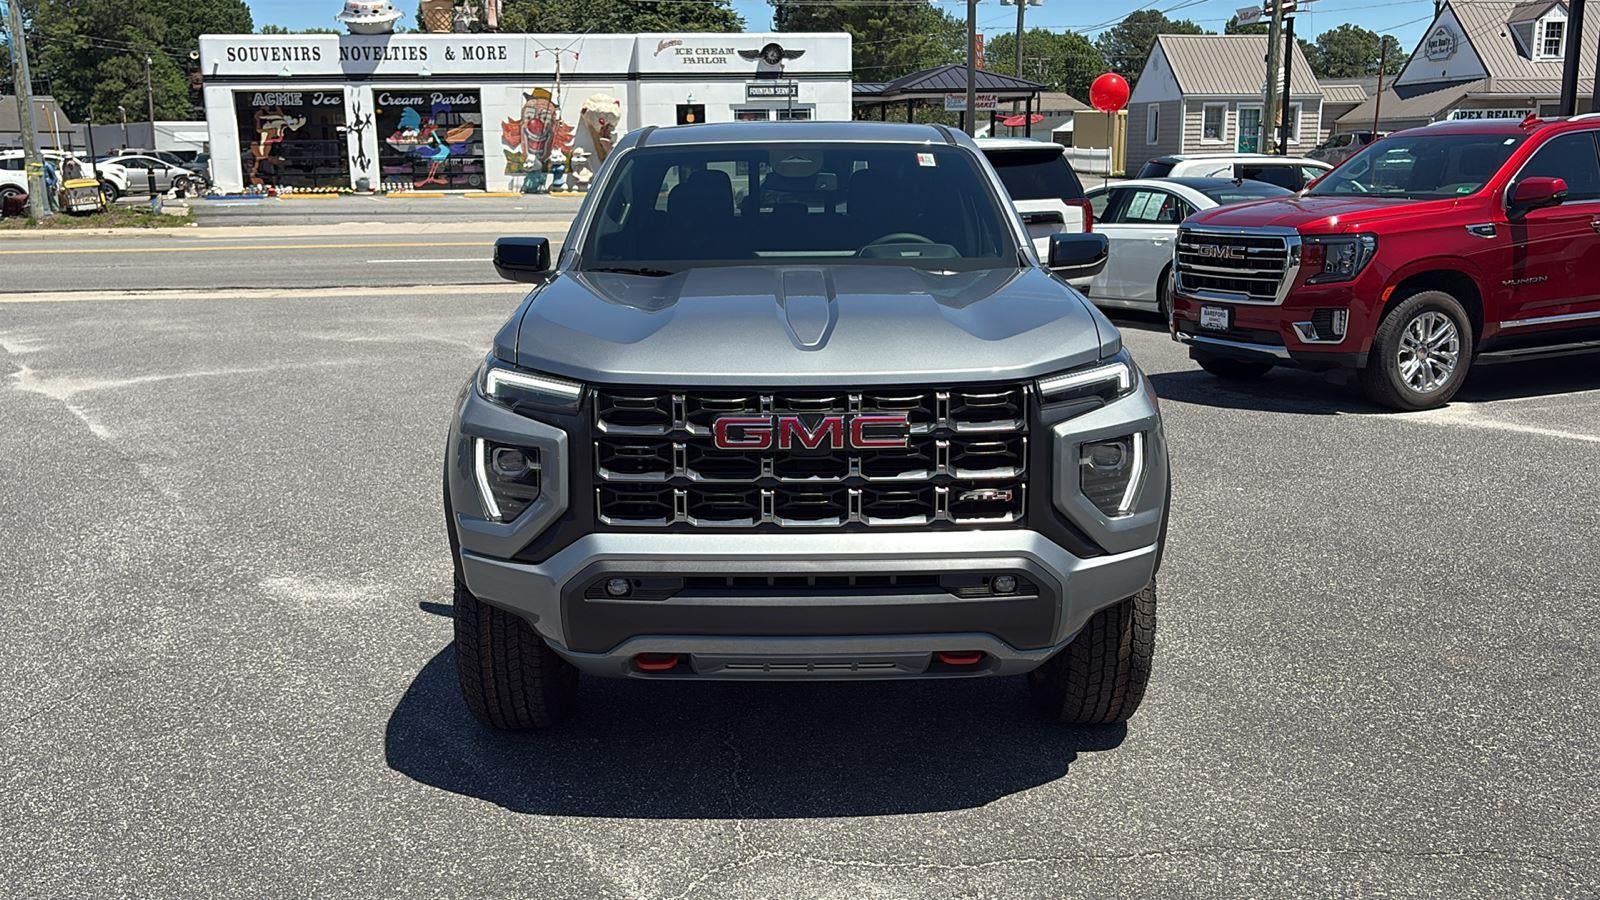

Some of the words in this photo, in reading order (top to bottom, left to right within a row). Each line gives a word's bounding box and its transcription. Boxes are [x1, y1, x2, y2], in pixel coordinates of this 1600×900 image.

[227, 46, 321, 61] SOUVENIRS
[339, 46, 428, 61] NOVELTIES
[444, 46, 455, 60] &
[462, 46, 507, 60] MORE
[695, 47, 735, 55] CREAM
[749, 87, 775, 95] FOUNTAIN
[775, 87, 797, 95] SERVCE
[252, 92, 303, 106] ACME
[312, 92, 342, 105] Ice
[378, 92, 424, 105] Cream
[430, 92, 477, 105] Parlor
[1452, 110, 1483, 120] APEX
[1487, 110, 1531, 119] REALTY
[1198, 243, 1246, 260] GMC
[1502, 276, 1548, 287] YUKON
[713, 414, 909, 450] GMC
